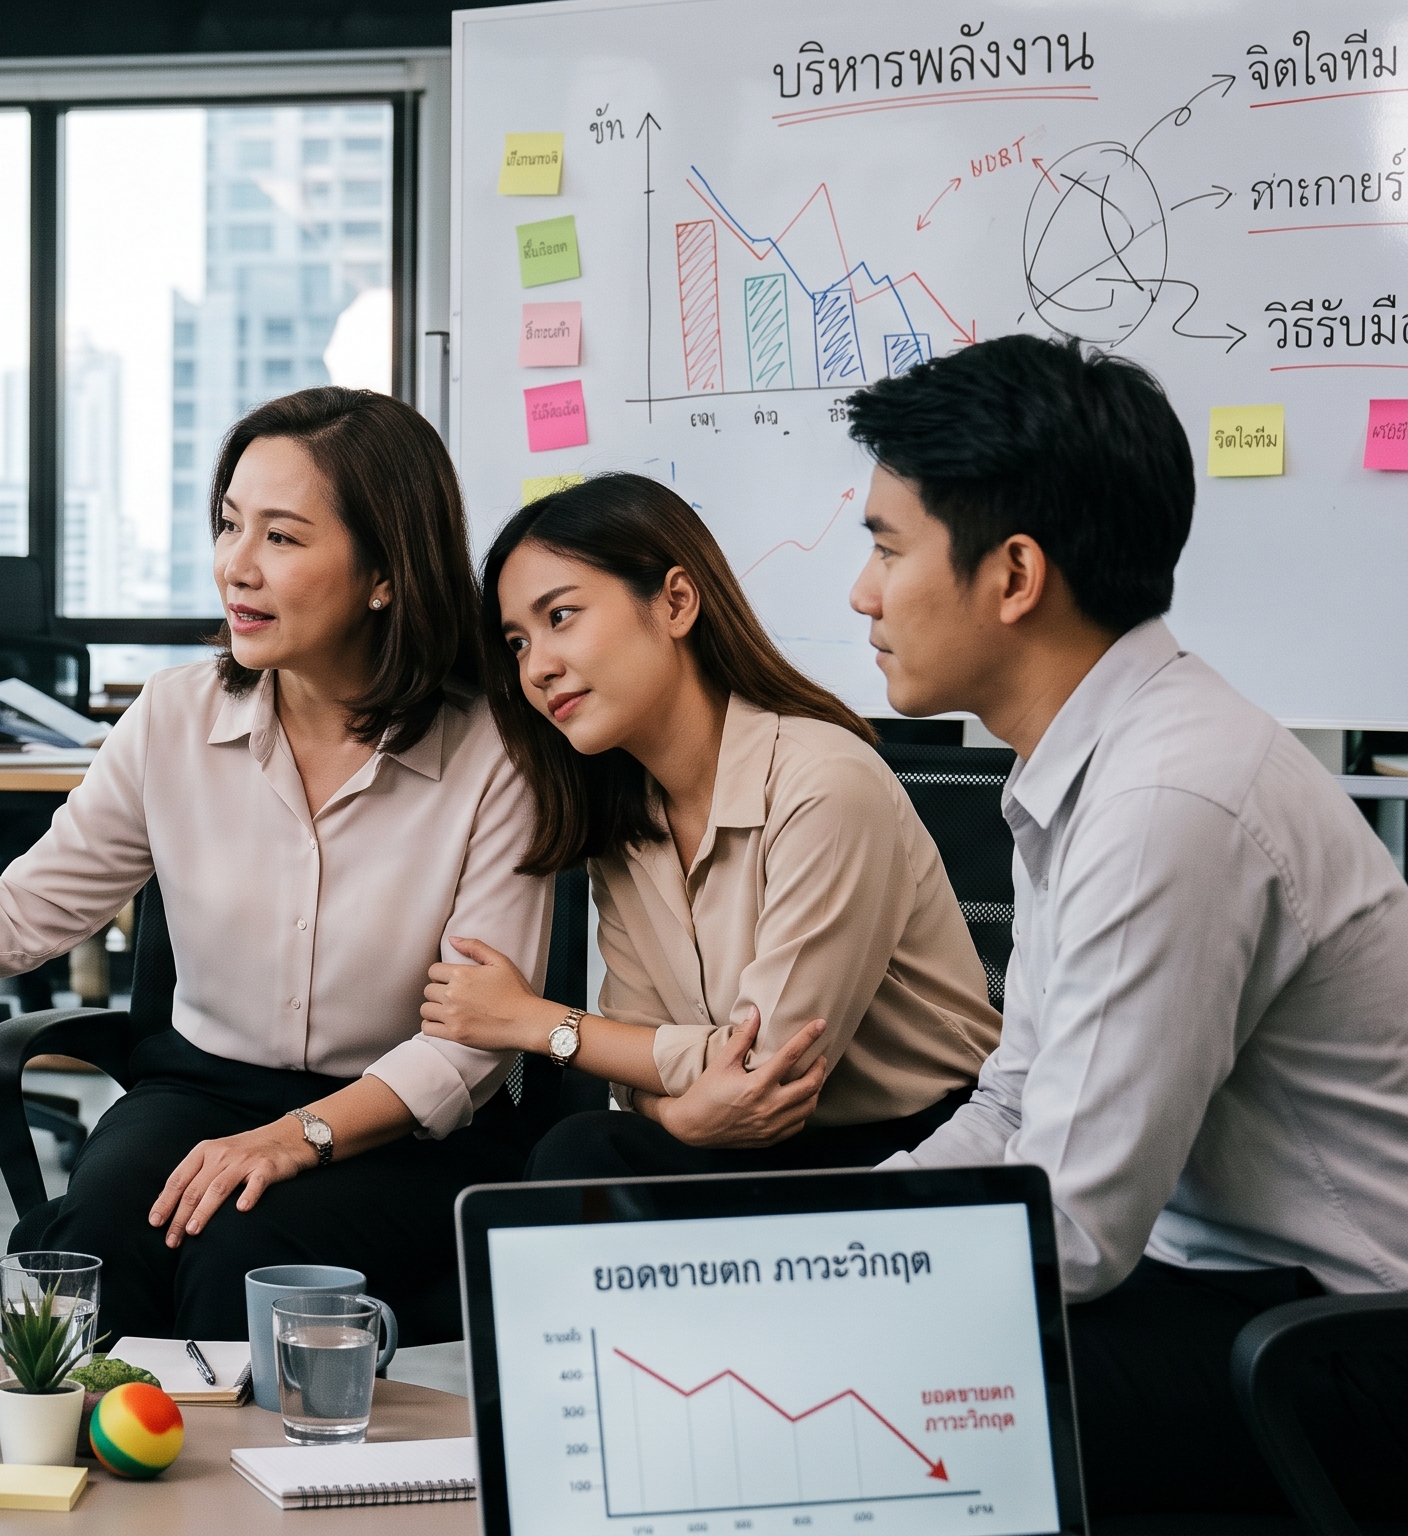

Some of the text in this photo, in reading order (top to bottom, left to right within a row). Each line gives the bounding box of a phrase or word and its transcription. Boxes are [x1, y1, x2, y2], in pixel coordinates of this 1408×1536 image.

[773, 21, 1094, 98] บริหารพลังงาน
[1246, 28, 1397, 90] จิตใจทีม
[593, 1241, 932, 1292] ยอดขายตก ภาวะวิกฤต
